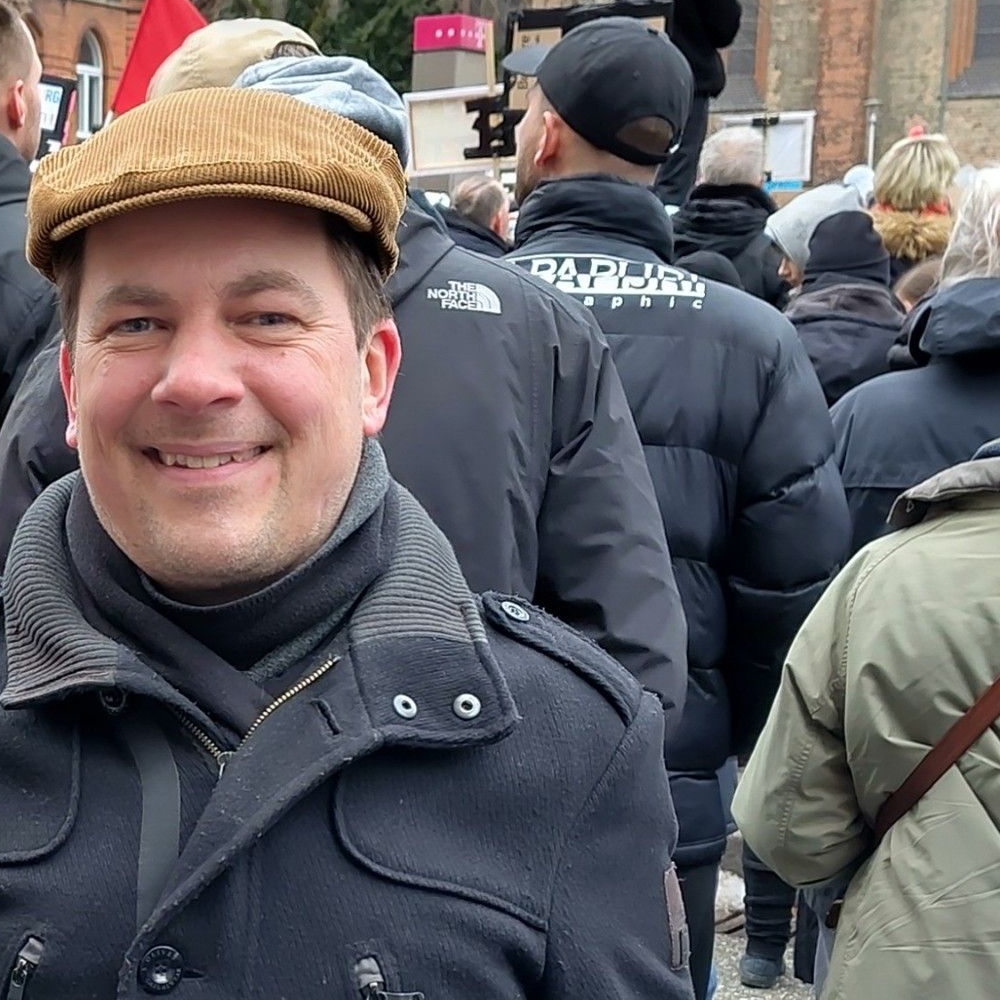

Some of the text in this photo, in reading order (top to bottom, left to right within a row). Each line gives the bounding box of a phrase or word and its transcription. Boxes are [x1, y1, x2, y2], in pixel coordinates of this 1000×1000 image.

[447, 280, 478, 292] THE
[427, 288, 477, 302] NORTH
[441, 299, 478, 311] FACE
